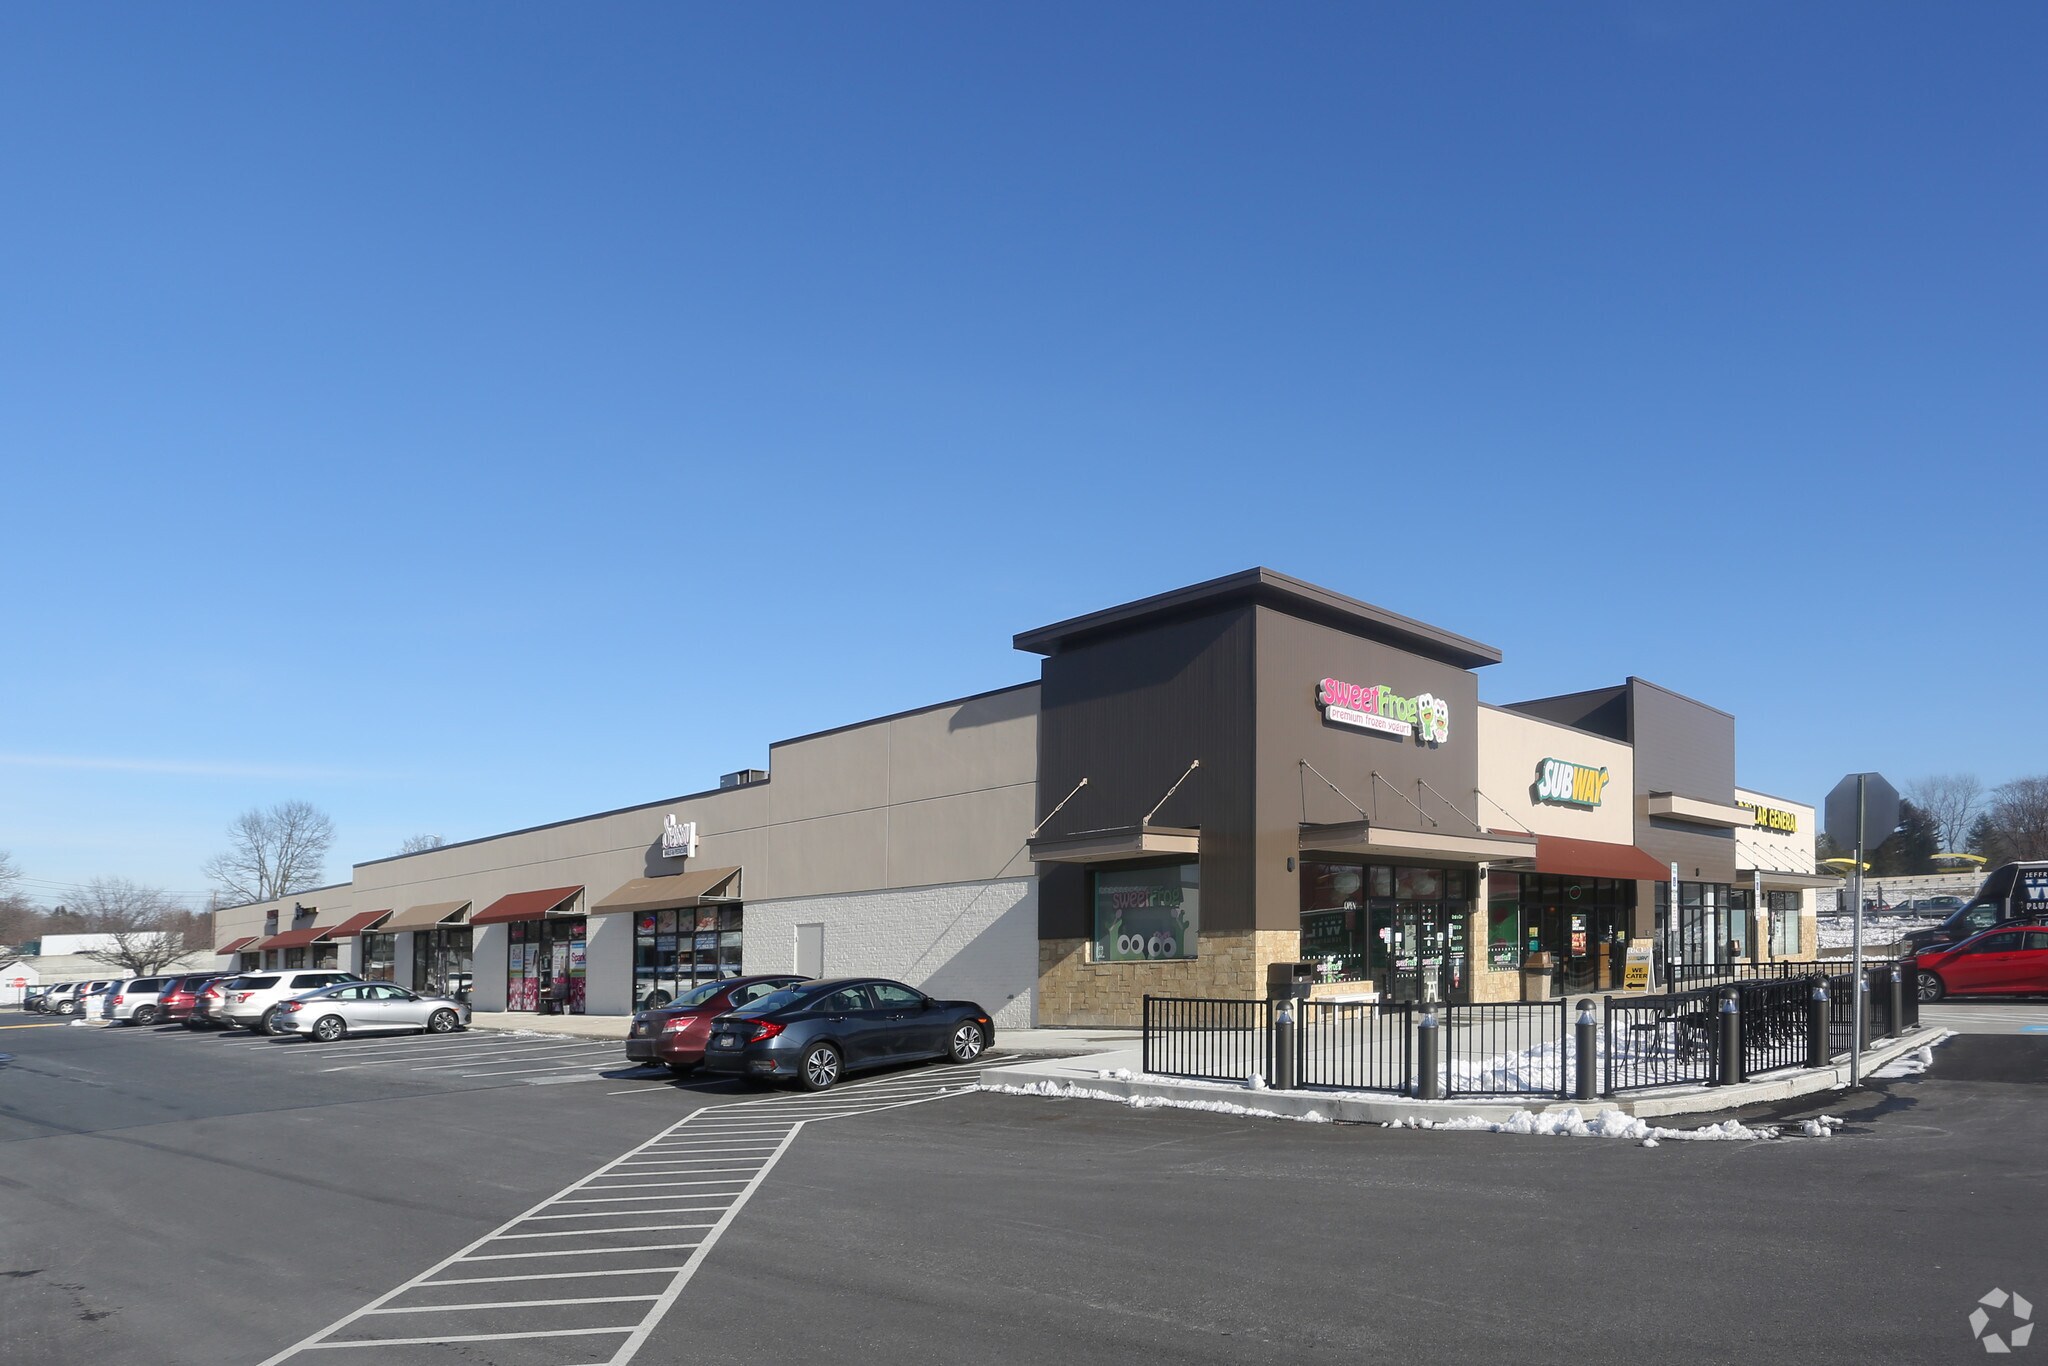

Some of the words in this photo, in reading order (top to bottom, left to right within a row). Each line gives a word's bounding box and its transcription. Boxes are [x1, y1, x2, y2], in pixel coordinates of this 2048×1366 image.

[1331, 710, 1363, 723] premium
[1365, 714, 1387, 730] frozen
[1388, 720, 1410, 734] yogurt
[1538, 760, 1608, 803] SUBWAY
[1769, 808, 1799, 832] GENERAL
[1343, 901, 1356, 910] OPEN
[2026, 902, 2048, 910] PLU
